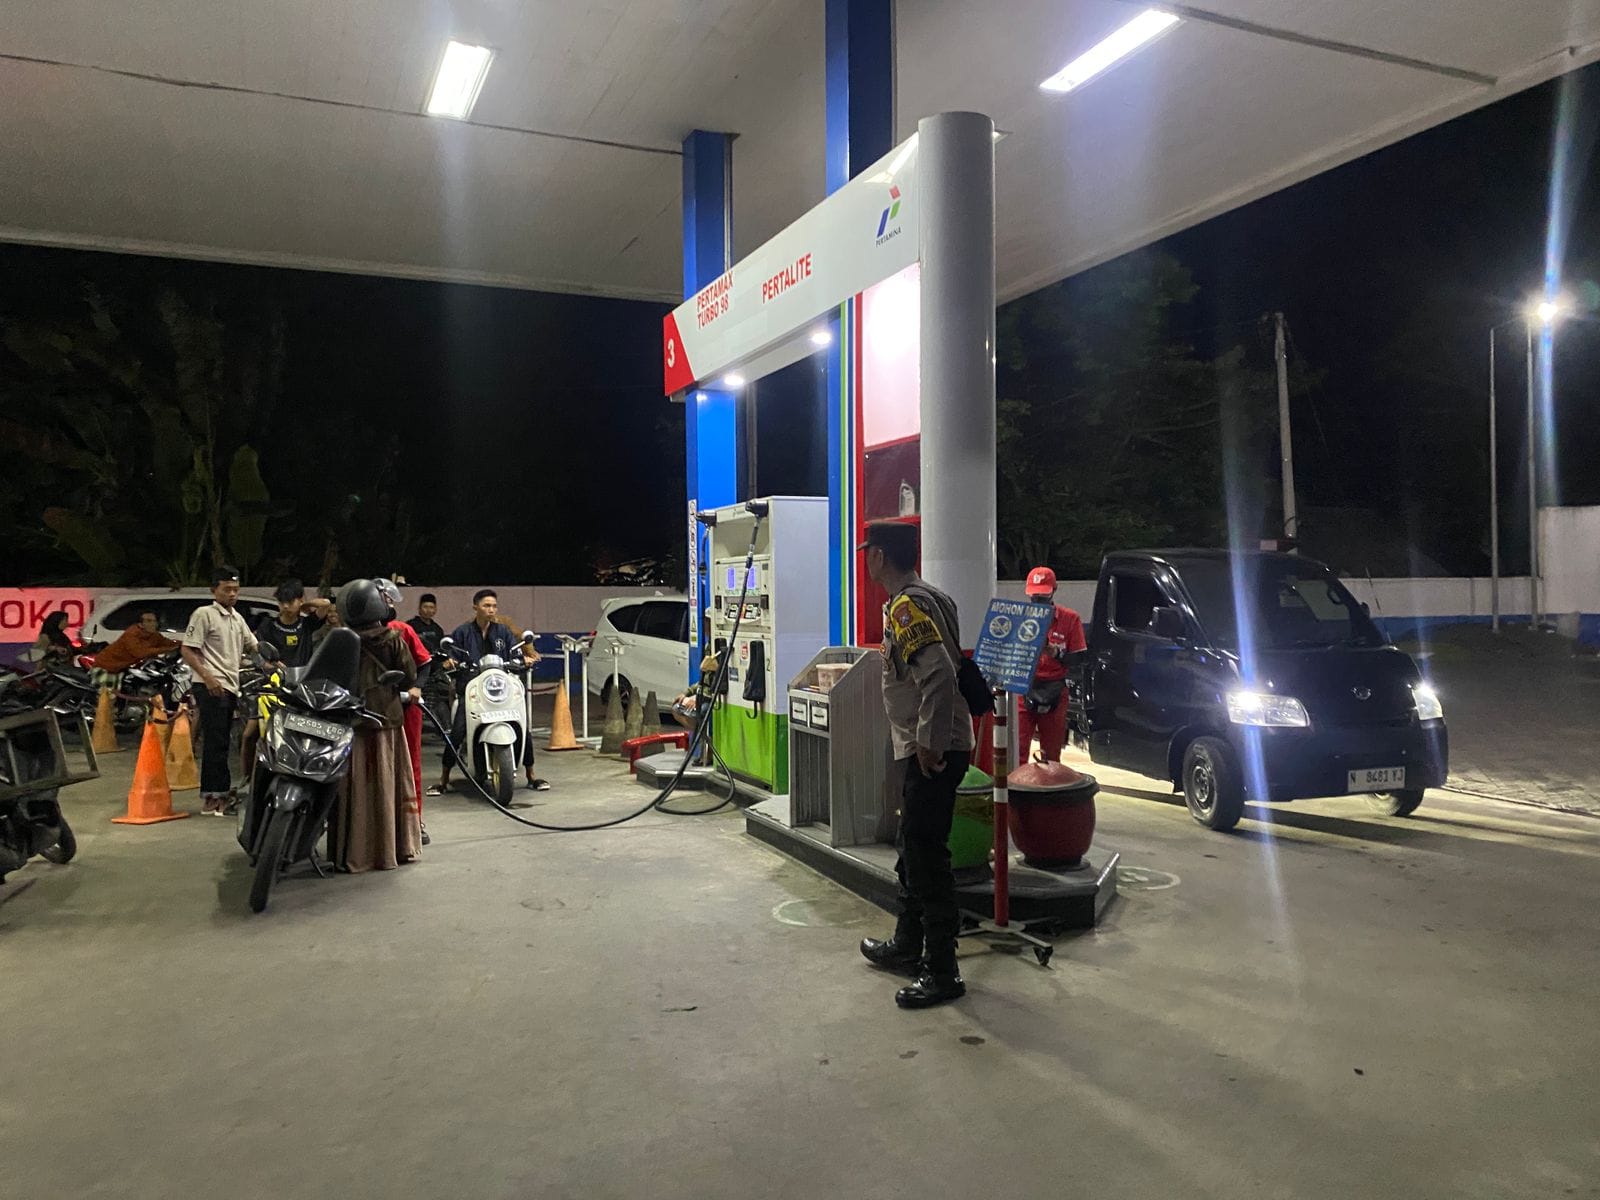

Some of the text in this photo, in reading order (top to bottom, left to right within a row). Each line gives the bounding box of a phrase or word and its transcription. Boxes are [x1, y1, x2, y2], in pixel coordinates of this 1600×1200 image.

[875, 226, 902, 248] PERTAMINA
[696, 270, 734, 313] PERTAMAX
[762, 253, 812, 304] PERTALITE
[697, 293, 729, 330] TURBO 98
[667, 338, 676, 368] 3
[991, 601, 1050, 619] MOHON MAAF
[1004, 668, 1030, 679] KASIH
[1350, 772, 1357, 783] N
